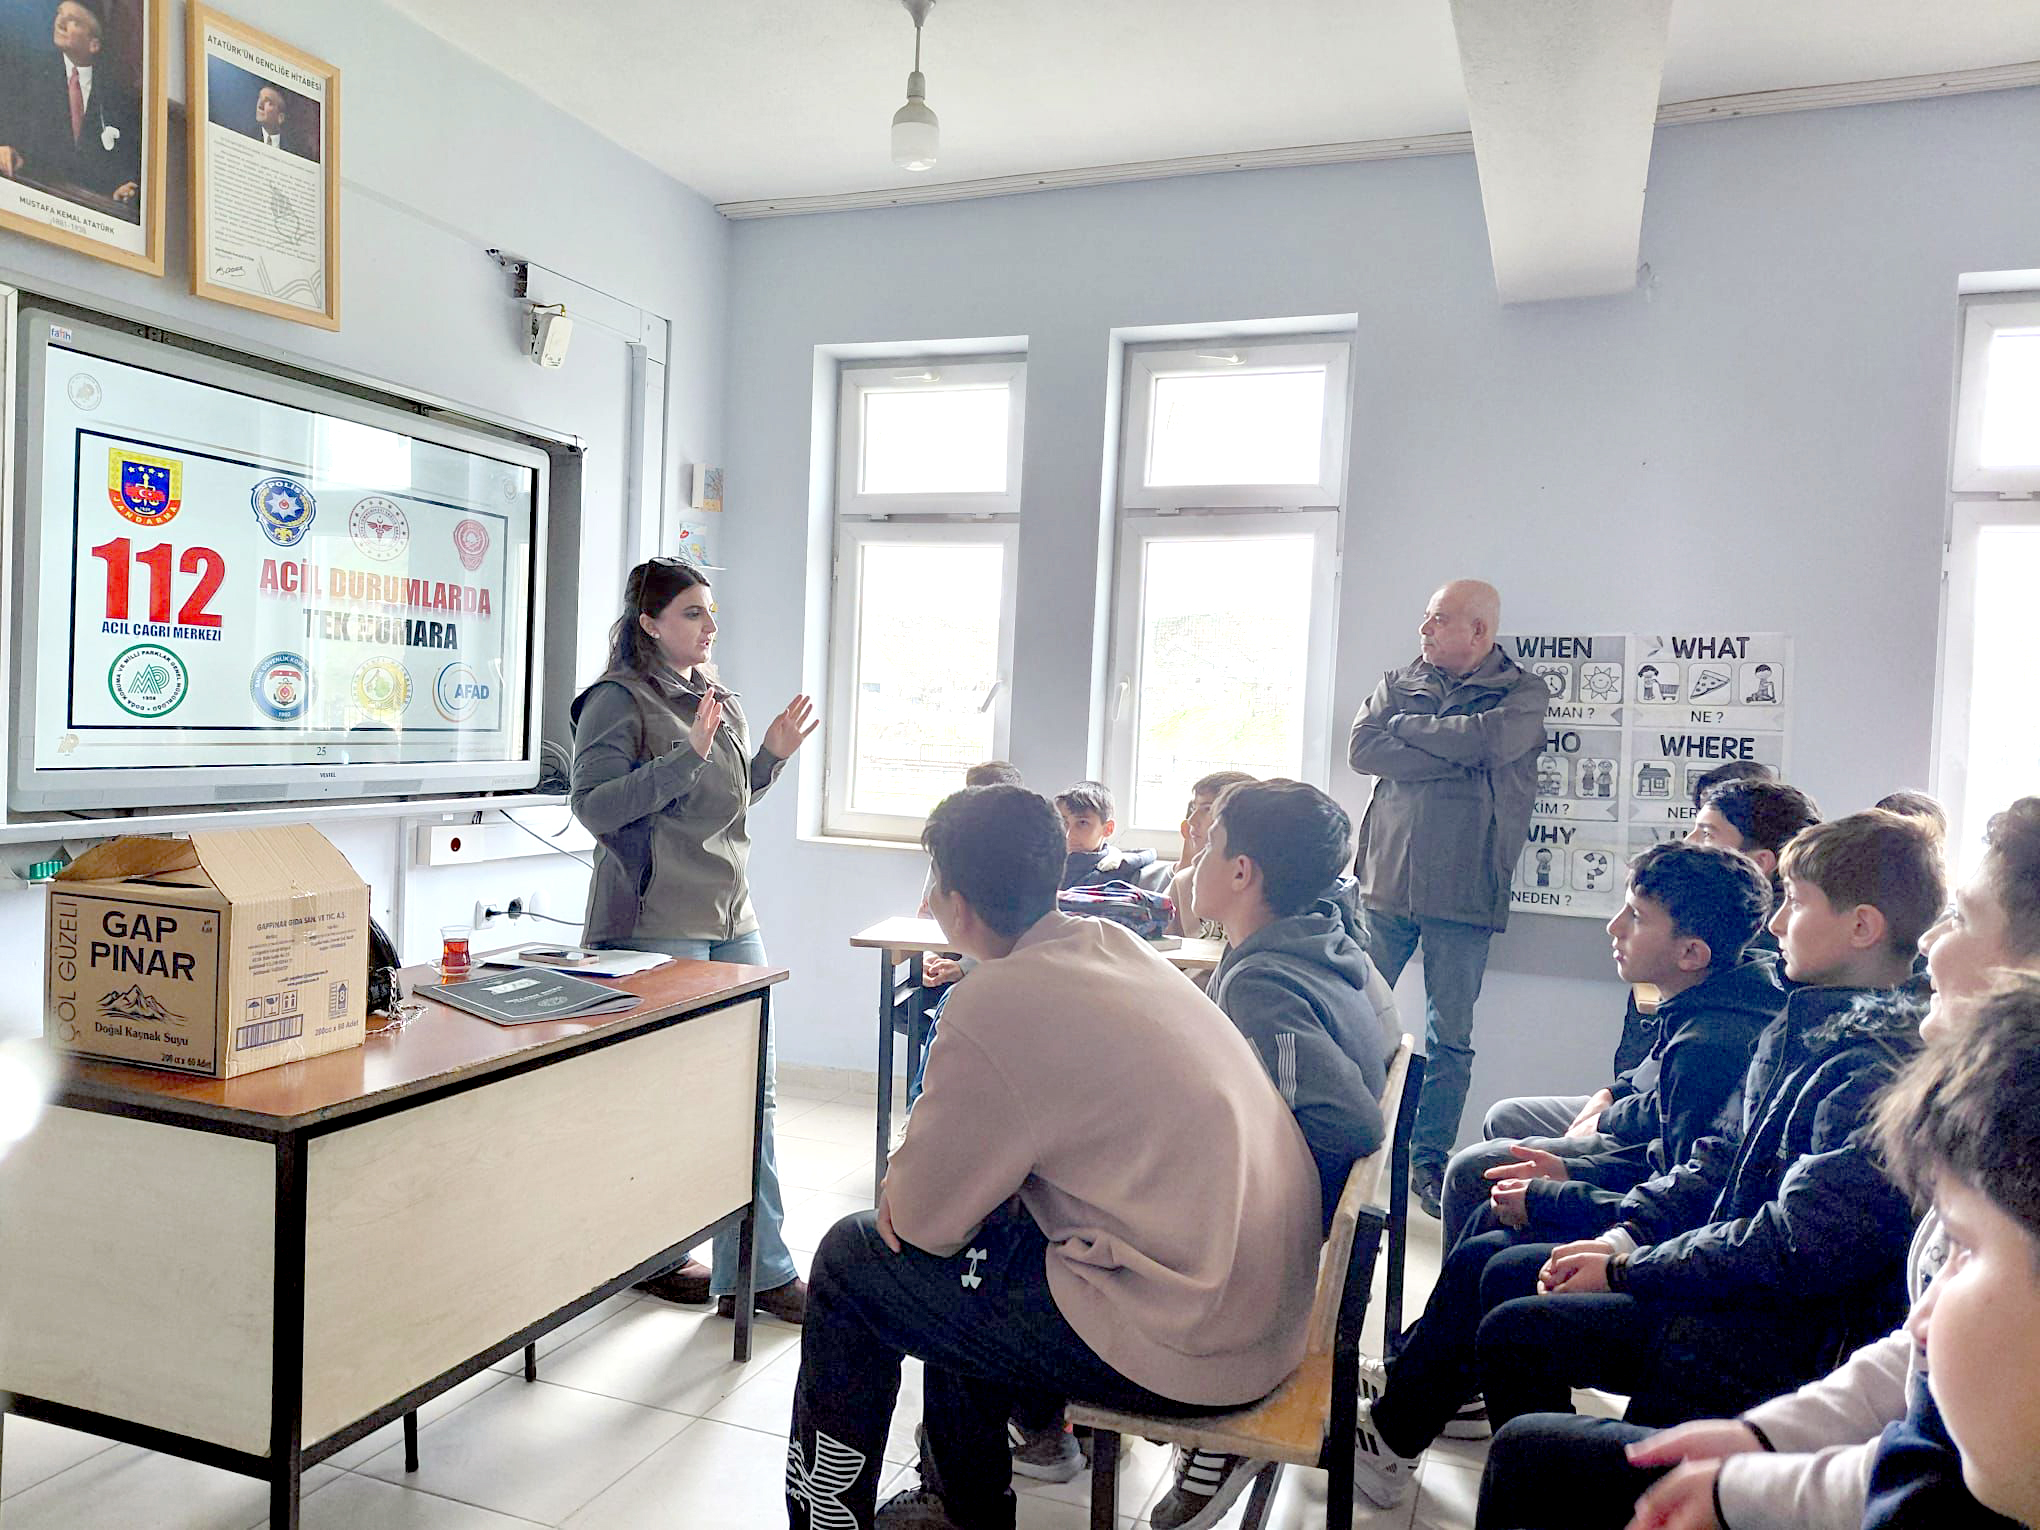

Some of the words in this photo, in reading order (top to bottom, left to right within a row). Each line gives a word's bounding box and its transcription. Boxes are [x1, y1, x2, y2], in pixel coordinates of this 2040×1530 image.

[19, 196, 55, 214] MUSTAFA
[56, 209, 81, 223] KEMAL
[83, 218, 115, 234] ATATÜRK
[112, 495, 177, 525] JANDARMA
[92, 537, 225, 627] 112
[259, 558, 322, 594] ACİL
[330, 567, 491, 615] DURUMLARDA
[303, 608, 351, 641] TEK
[1516, 636, 1593, 659] WHEN
[1671, 636, 1750, 660] WHAT
[454, 683, 490, 700] AFAD
[1544, 706, 1583, 719] MAN
[1691, 711, 1712, 723] NE
[1716, 711, 1724, 724] ?
[316, 746, 327, 756] 25
[1544, 731, 1581, 753] HO
[1660, 734, 1755, 760] WHERE
[1667, 807, 1697, 819] NER
[1511, 891, 1561, 906] NEDEN
[102, 910, 178, 943] GAP
[90, 941, 196, 982] PINAR
[53, 991, 82, 1042] ÇÖL
[95, 1021, 123, 1036] Doğal
[125, 1026, 161, 1042] Kaynak
[164, 1032, 188, 1047] Suyu
